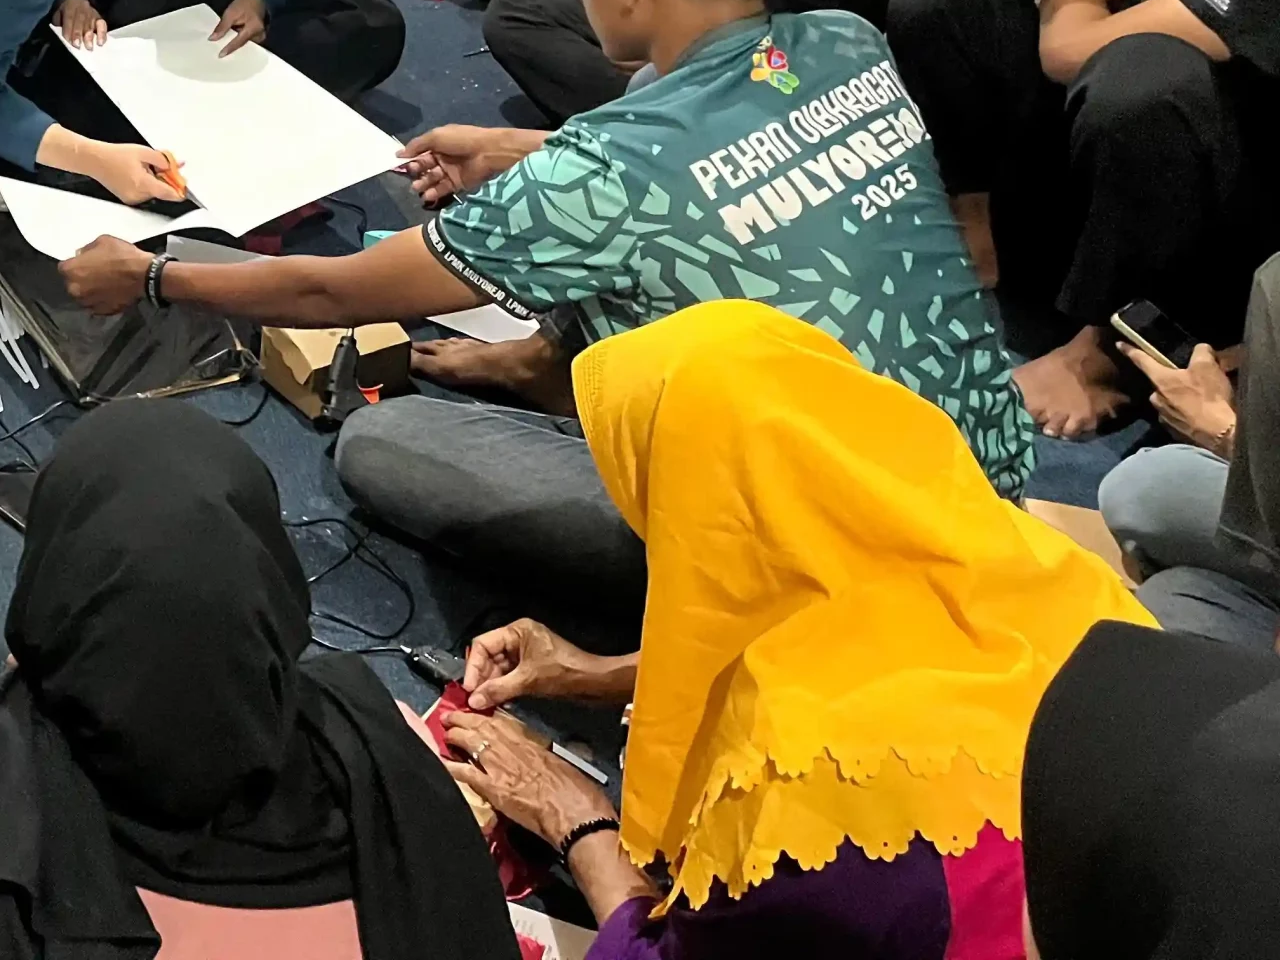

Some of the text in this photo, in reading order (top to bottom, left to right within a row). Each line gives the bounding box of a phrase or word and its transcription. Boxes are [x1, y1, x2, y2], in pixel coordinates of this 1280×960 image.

[689, 122, 802, 200] PEKAN
[851, 163, 917, 221] 2025
[463, 267, 506, 301] MULYOREJO
